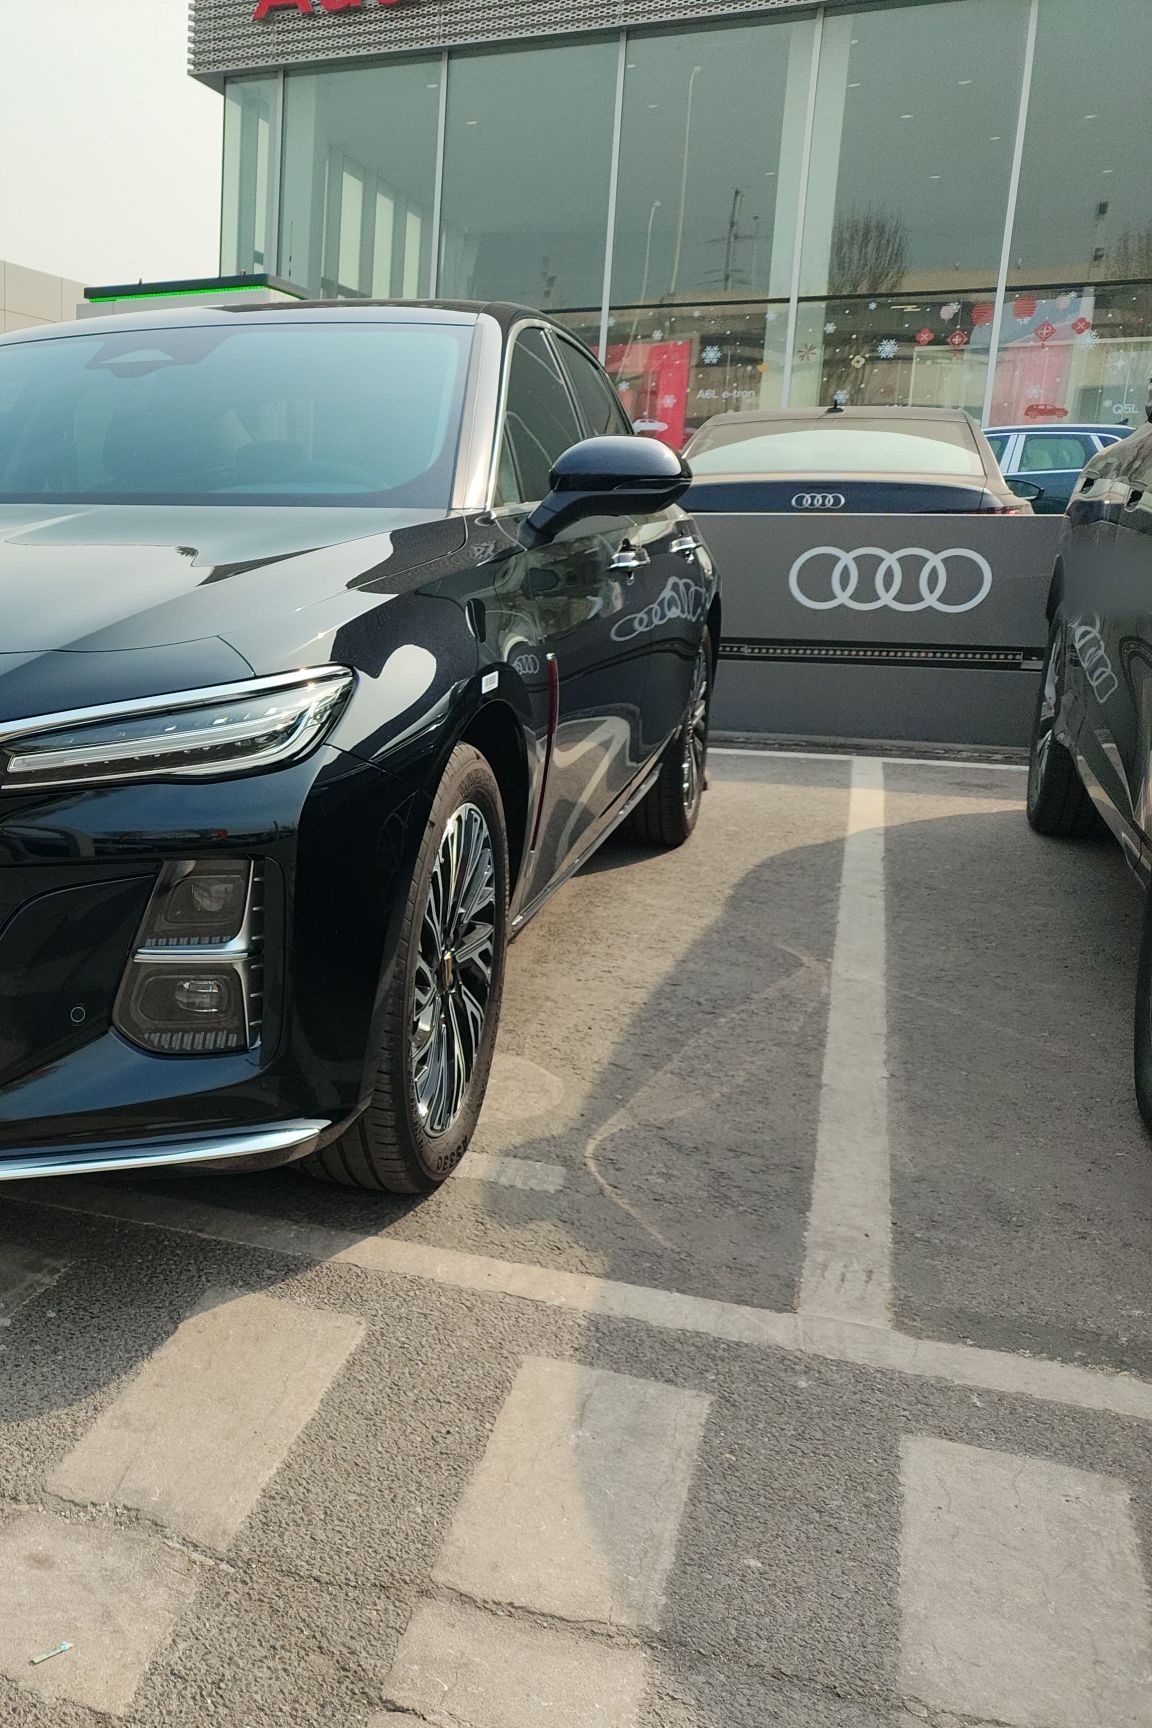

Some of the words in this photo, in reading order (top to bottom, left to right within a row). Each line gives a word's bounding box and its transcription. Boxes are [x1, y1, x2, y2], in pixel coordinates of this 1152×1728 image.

[696, 389, 719, 399] A6L
[721, 390, 755, 399] e-tron
[1112, 403, 1140, 414] Q5L
